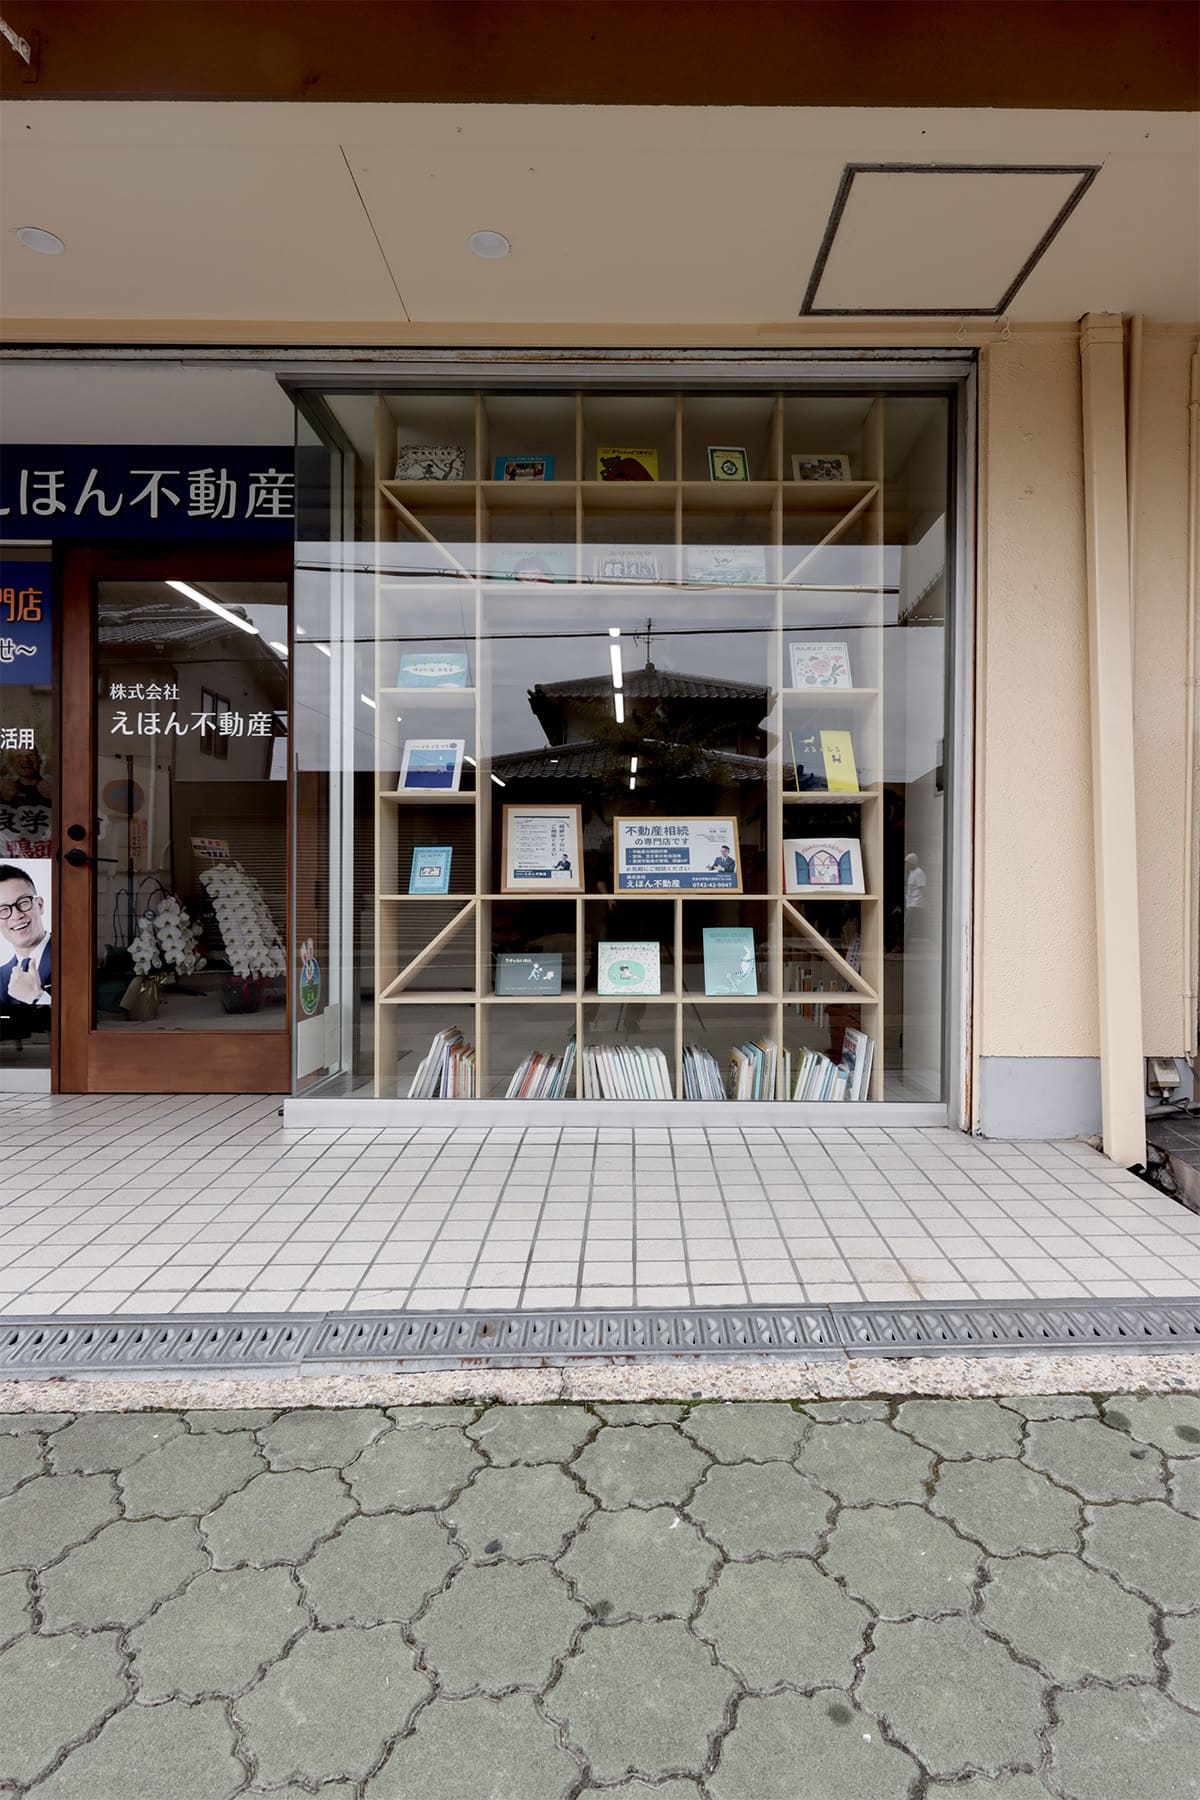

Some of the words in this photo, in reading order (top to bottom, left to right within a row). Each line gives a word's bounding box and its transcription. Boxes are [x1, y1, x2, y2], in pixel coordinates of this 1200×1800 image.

[0, 468, 295, 519] ほん不動産
[109, 683, 180, 701] 株式会社
[110, 711, 273, 738] えほん不動産
[0, 728, 35, 750] 活用
[625, 825, 690, 837] 不動産相続
[634, 837, 690, 846] の専門店です
[626, 879, 681, 888] えほん不動産
